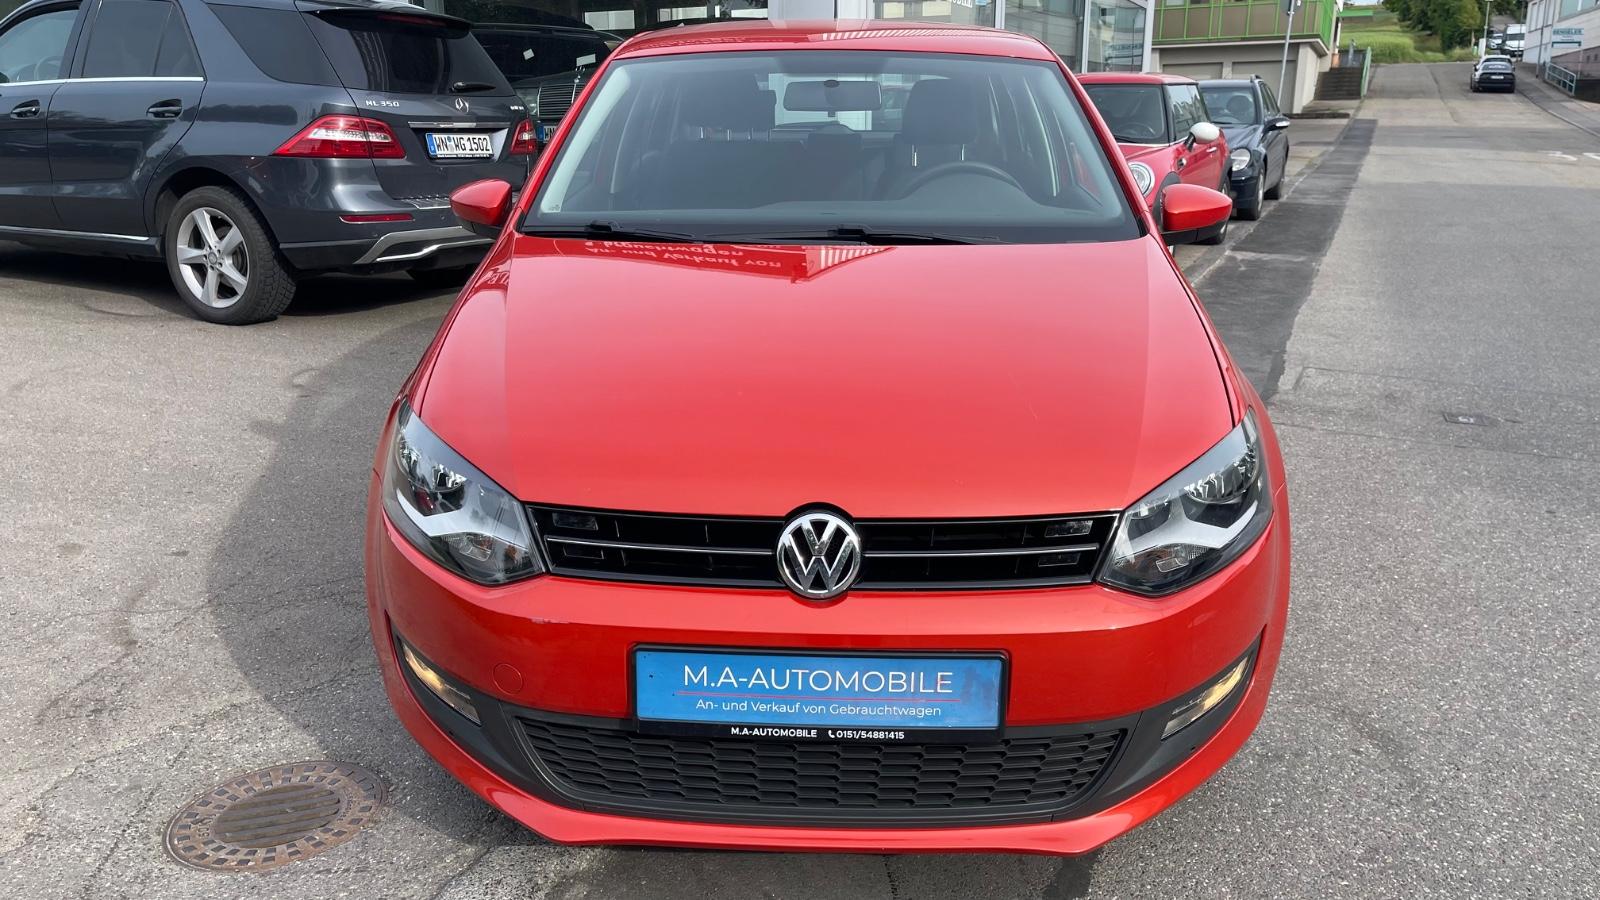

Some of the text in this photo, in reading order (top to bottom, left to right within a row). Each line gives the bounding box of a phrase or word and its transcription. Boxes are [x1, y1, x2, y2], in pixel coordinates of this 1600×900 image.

[434, 135, 490, 152] WN WG 1502
[780, 516, 859, 594] VW
[683, 664, 954, 694] M.A-AUTOMOBILE
[696, 699, 942, 718] An- und Verkauf von Gebrauchtwagen
[731, 726, 905, 740] M.A-AUTOMOBILE 0151/54881415
